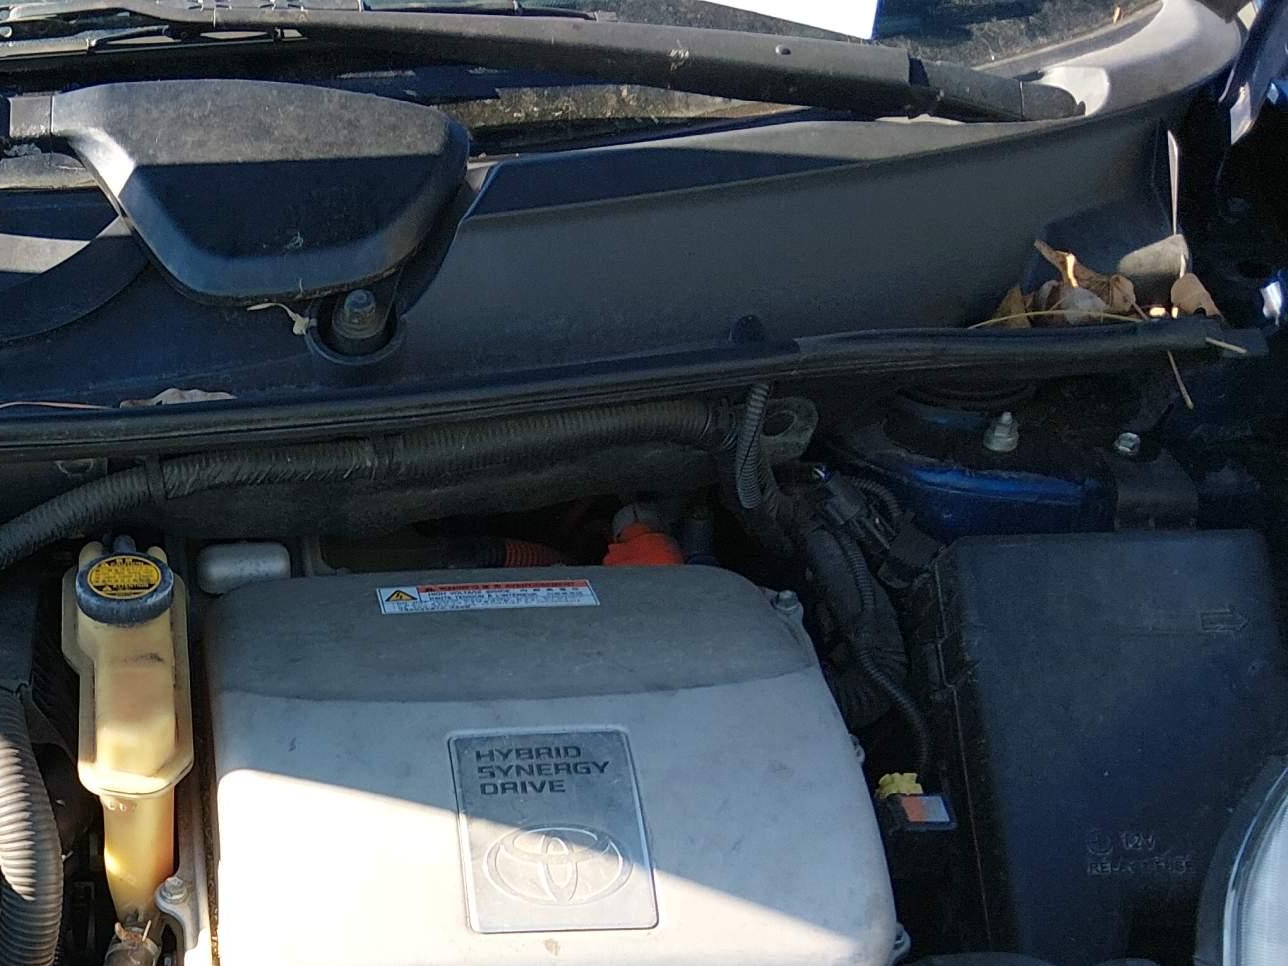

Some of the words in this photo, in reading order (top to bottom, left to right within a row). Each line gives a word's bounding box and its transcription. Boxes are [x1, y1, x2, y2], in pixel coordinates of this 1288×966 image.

[476, 746, 581, 762] HYBRID
[478, 761, 610, 779] SYNERGY
[480, 780, 566, 795] DRIVE
